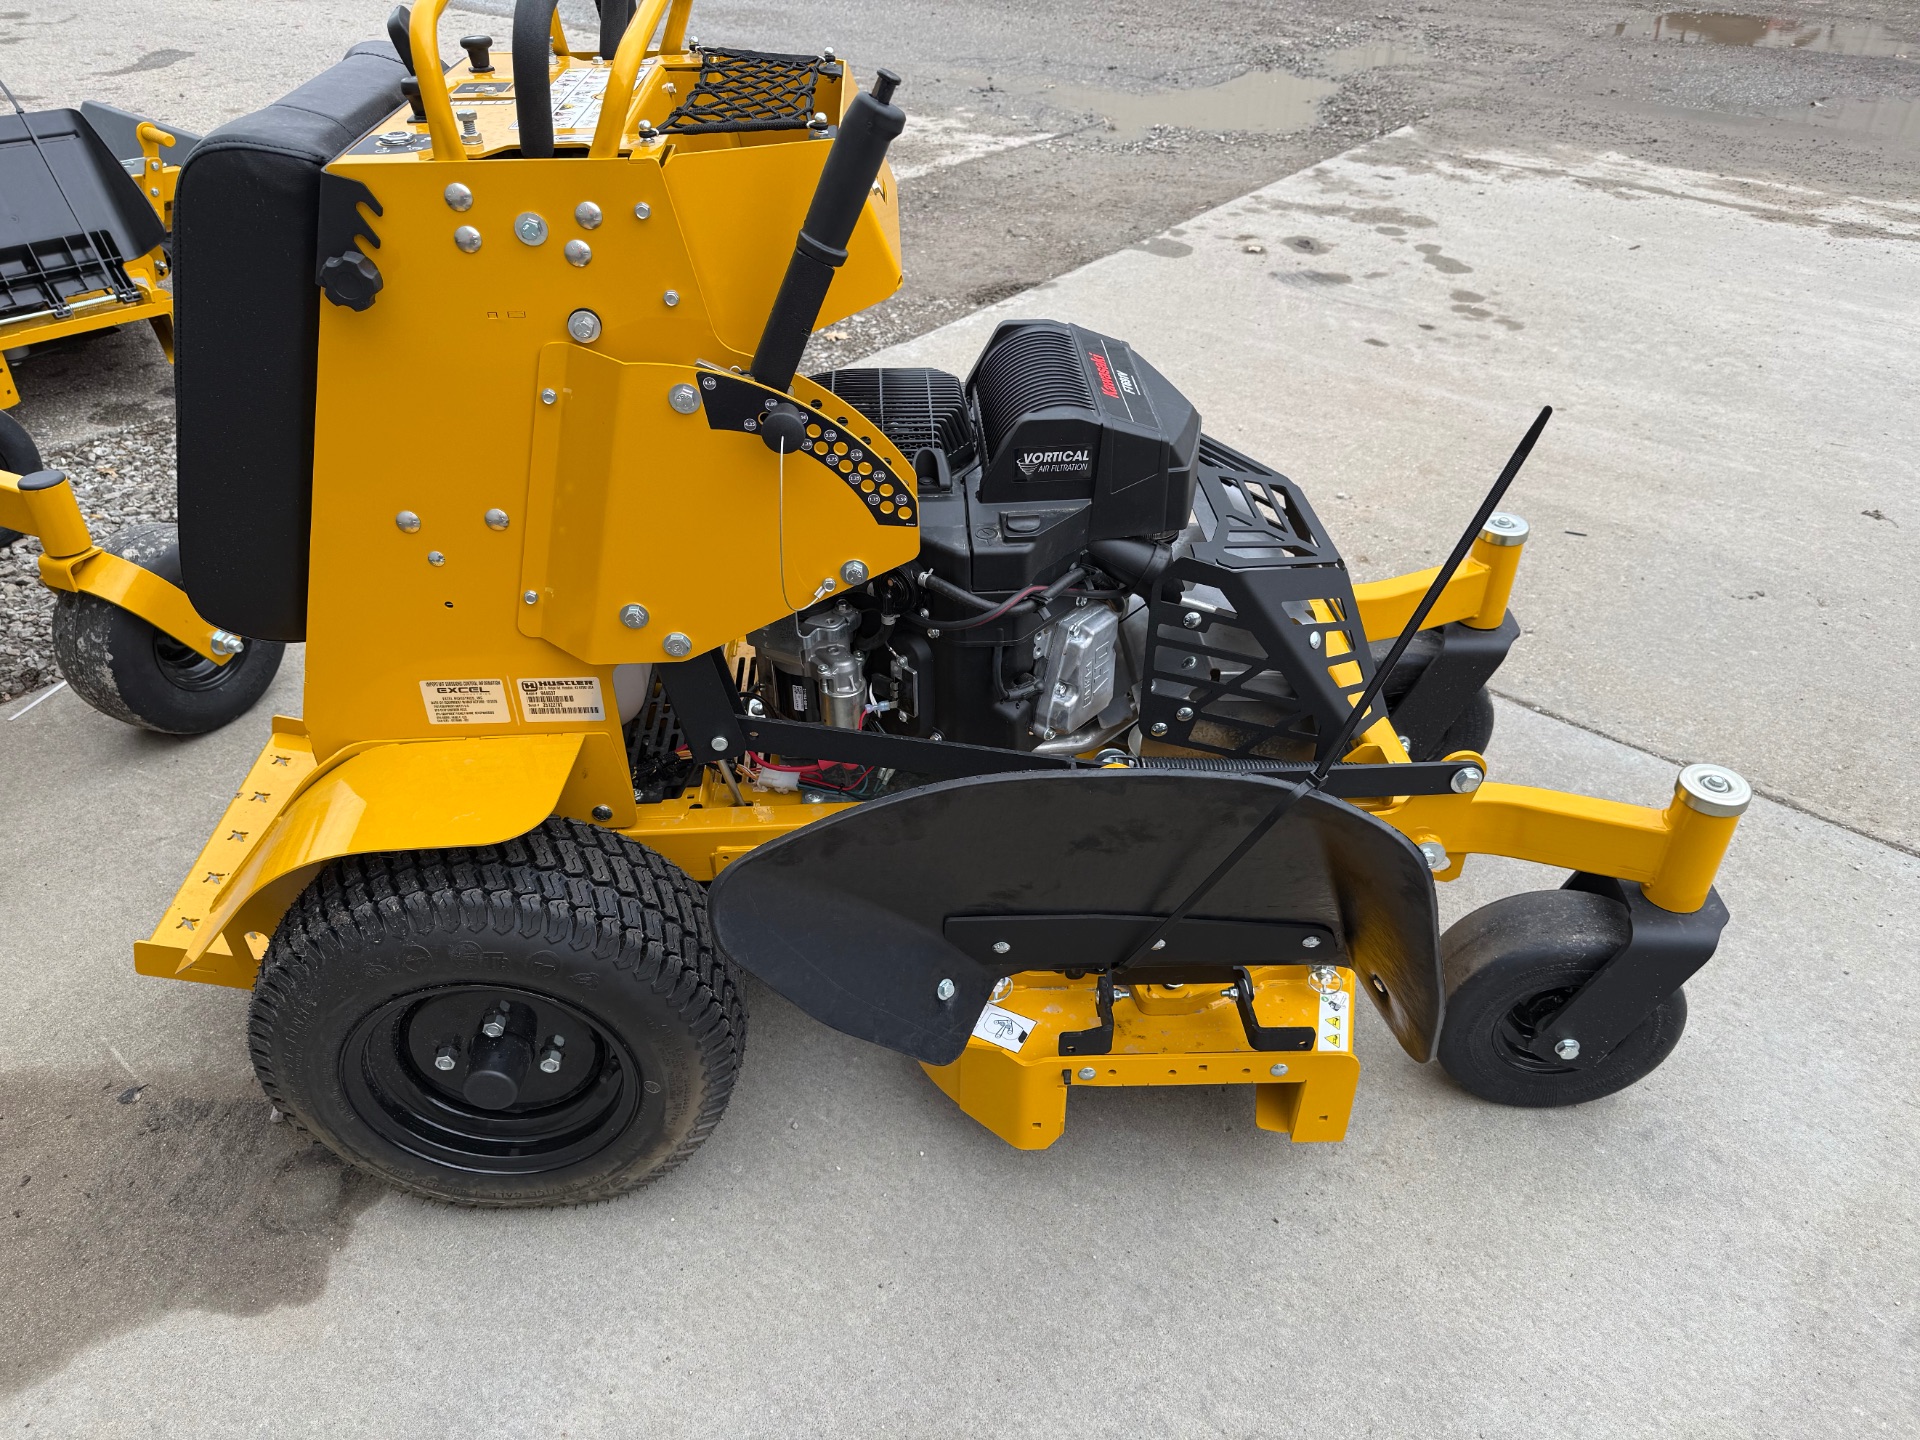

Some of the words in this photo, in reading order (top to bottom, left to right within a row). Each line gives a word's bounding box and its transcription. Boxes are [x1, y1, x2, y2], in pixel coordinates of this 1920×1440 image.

[1088, 351, 1119, 399] Kawasaki
[1023, 449, 1090, 464] VORTICAL
[1038, 465, 1050, 473] AIR
[1051, 462, 1088, 473] FILTRATION
[586, 1172, 605, 1187] FOR
[489, 1190, 523, 1200] CALL
[529, 1182, 580, 1199] SERVICE
